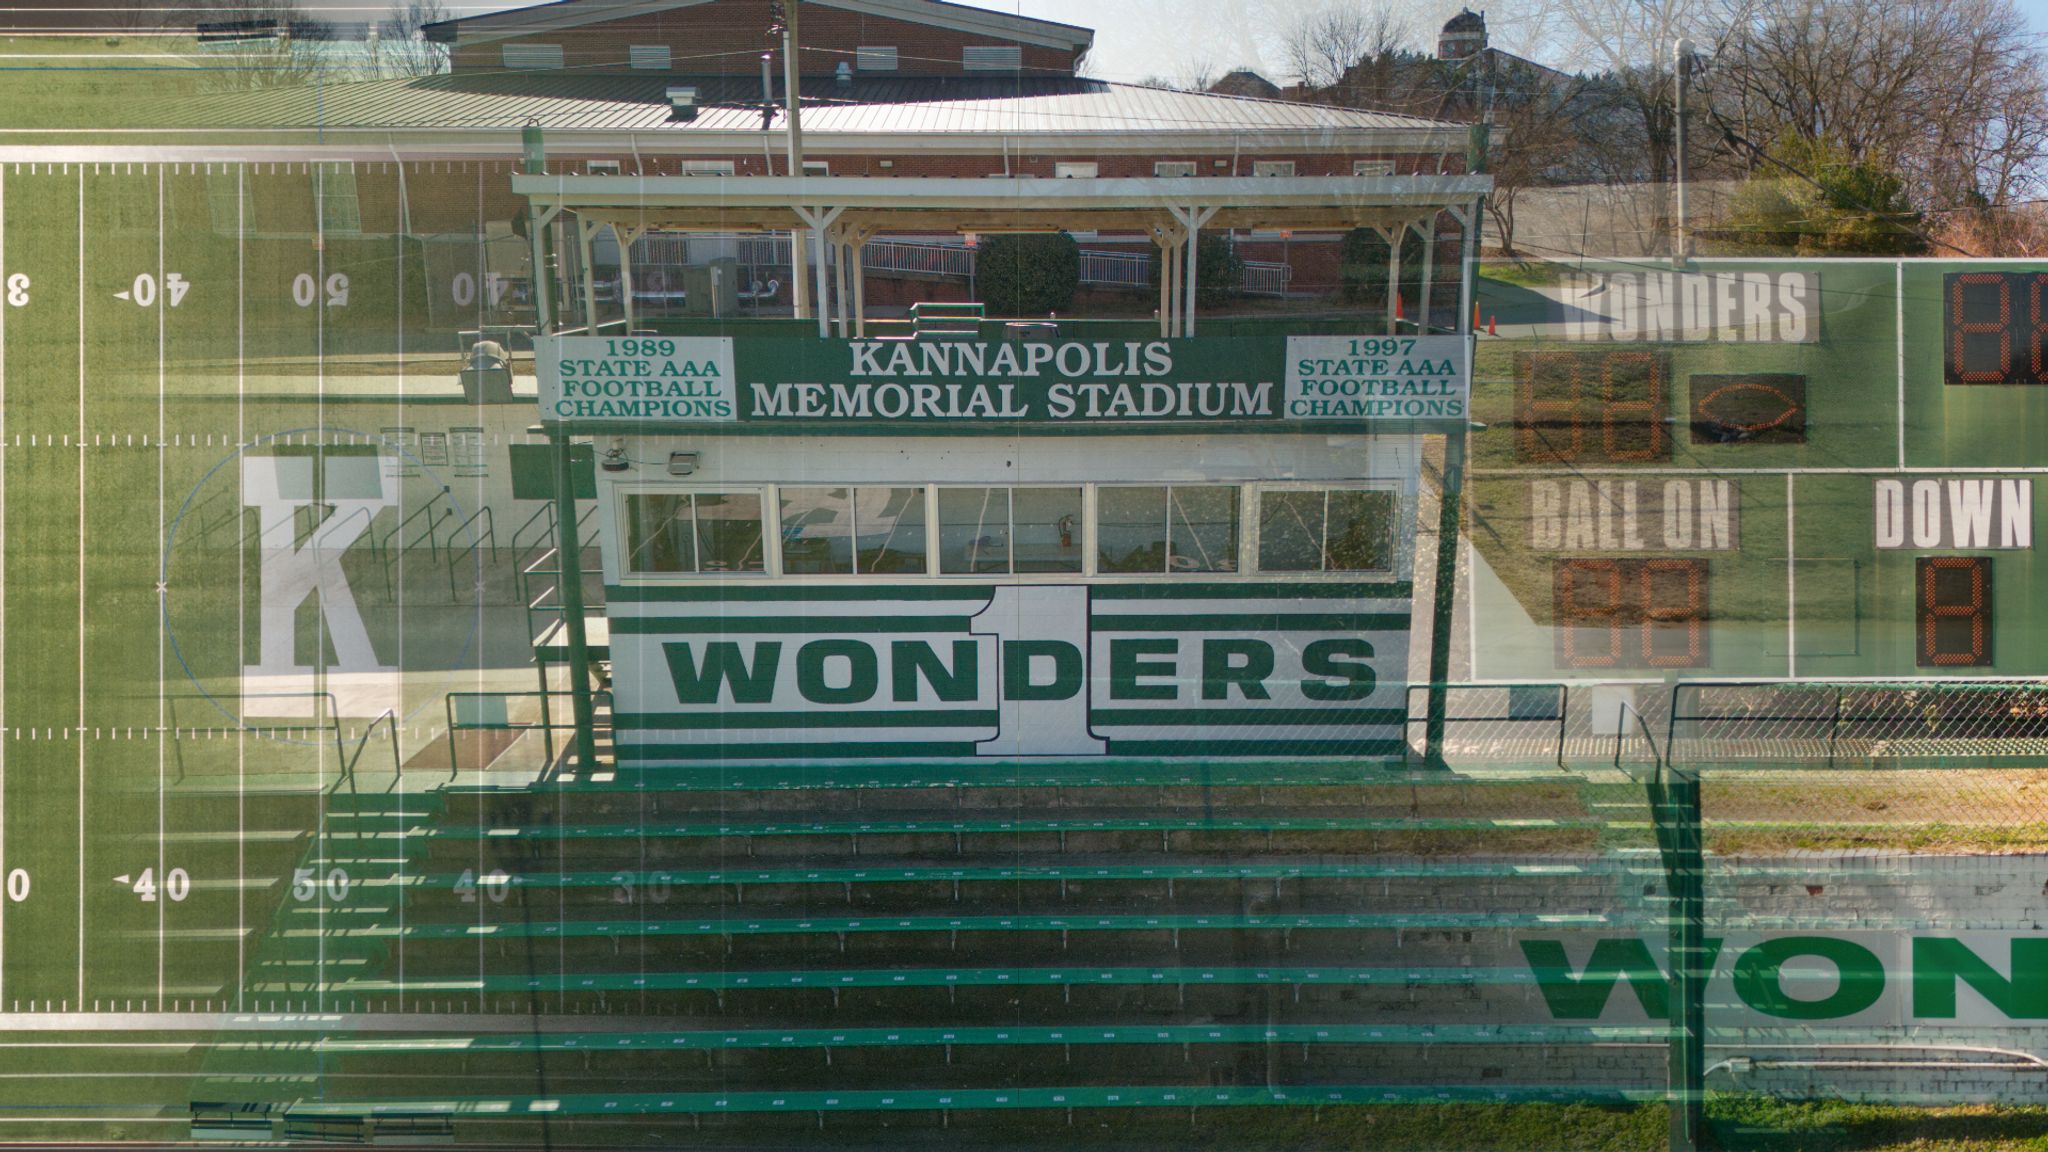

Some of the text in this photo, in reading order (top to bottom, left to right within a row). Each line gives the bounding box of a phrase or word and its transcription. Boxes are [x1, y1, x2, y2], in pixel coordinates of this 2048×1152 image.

[1559, 272, 1807, 343] WONDERS
[606, 340, 676, 357] 1989
[849, 342, 1172, 376] KANNAPOLIS
[1347, 338, 1417, 356] 1997
[559, 360, 721, 377] STATE AAA
[1298, 359, 1456, 376] STATE AAA
[562, 380, 722, 397] FOOTBALL
[750, 382, 1273, 418] MEMORIAL STADIUM
[1300, 379, 1456, 397] FOOTBALL
[554, 400, 731, 418] CHAMPIONS
[1290, 399, 1463, 417] CHAMPIONS
[1531, 479, 1730, 549] BALL ON
[1875, 478, 2032, 548] DOWN
[243, 456, 399, 718] K
[661, 638, 1377, 704] WONDERS
[133, 868, 190, 901] 40
[293, 868, 349, 901] 50
[1519, 935, 2048, 1020] WON
